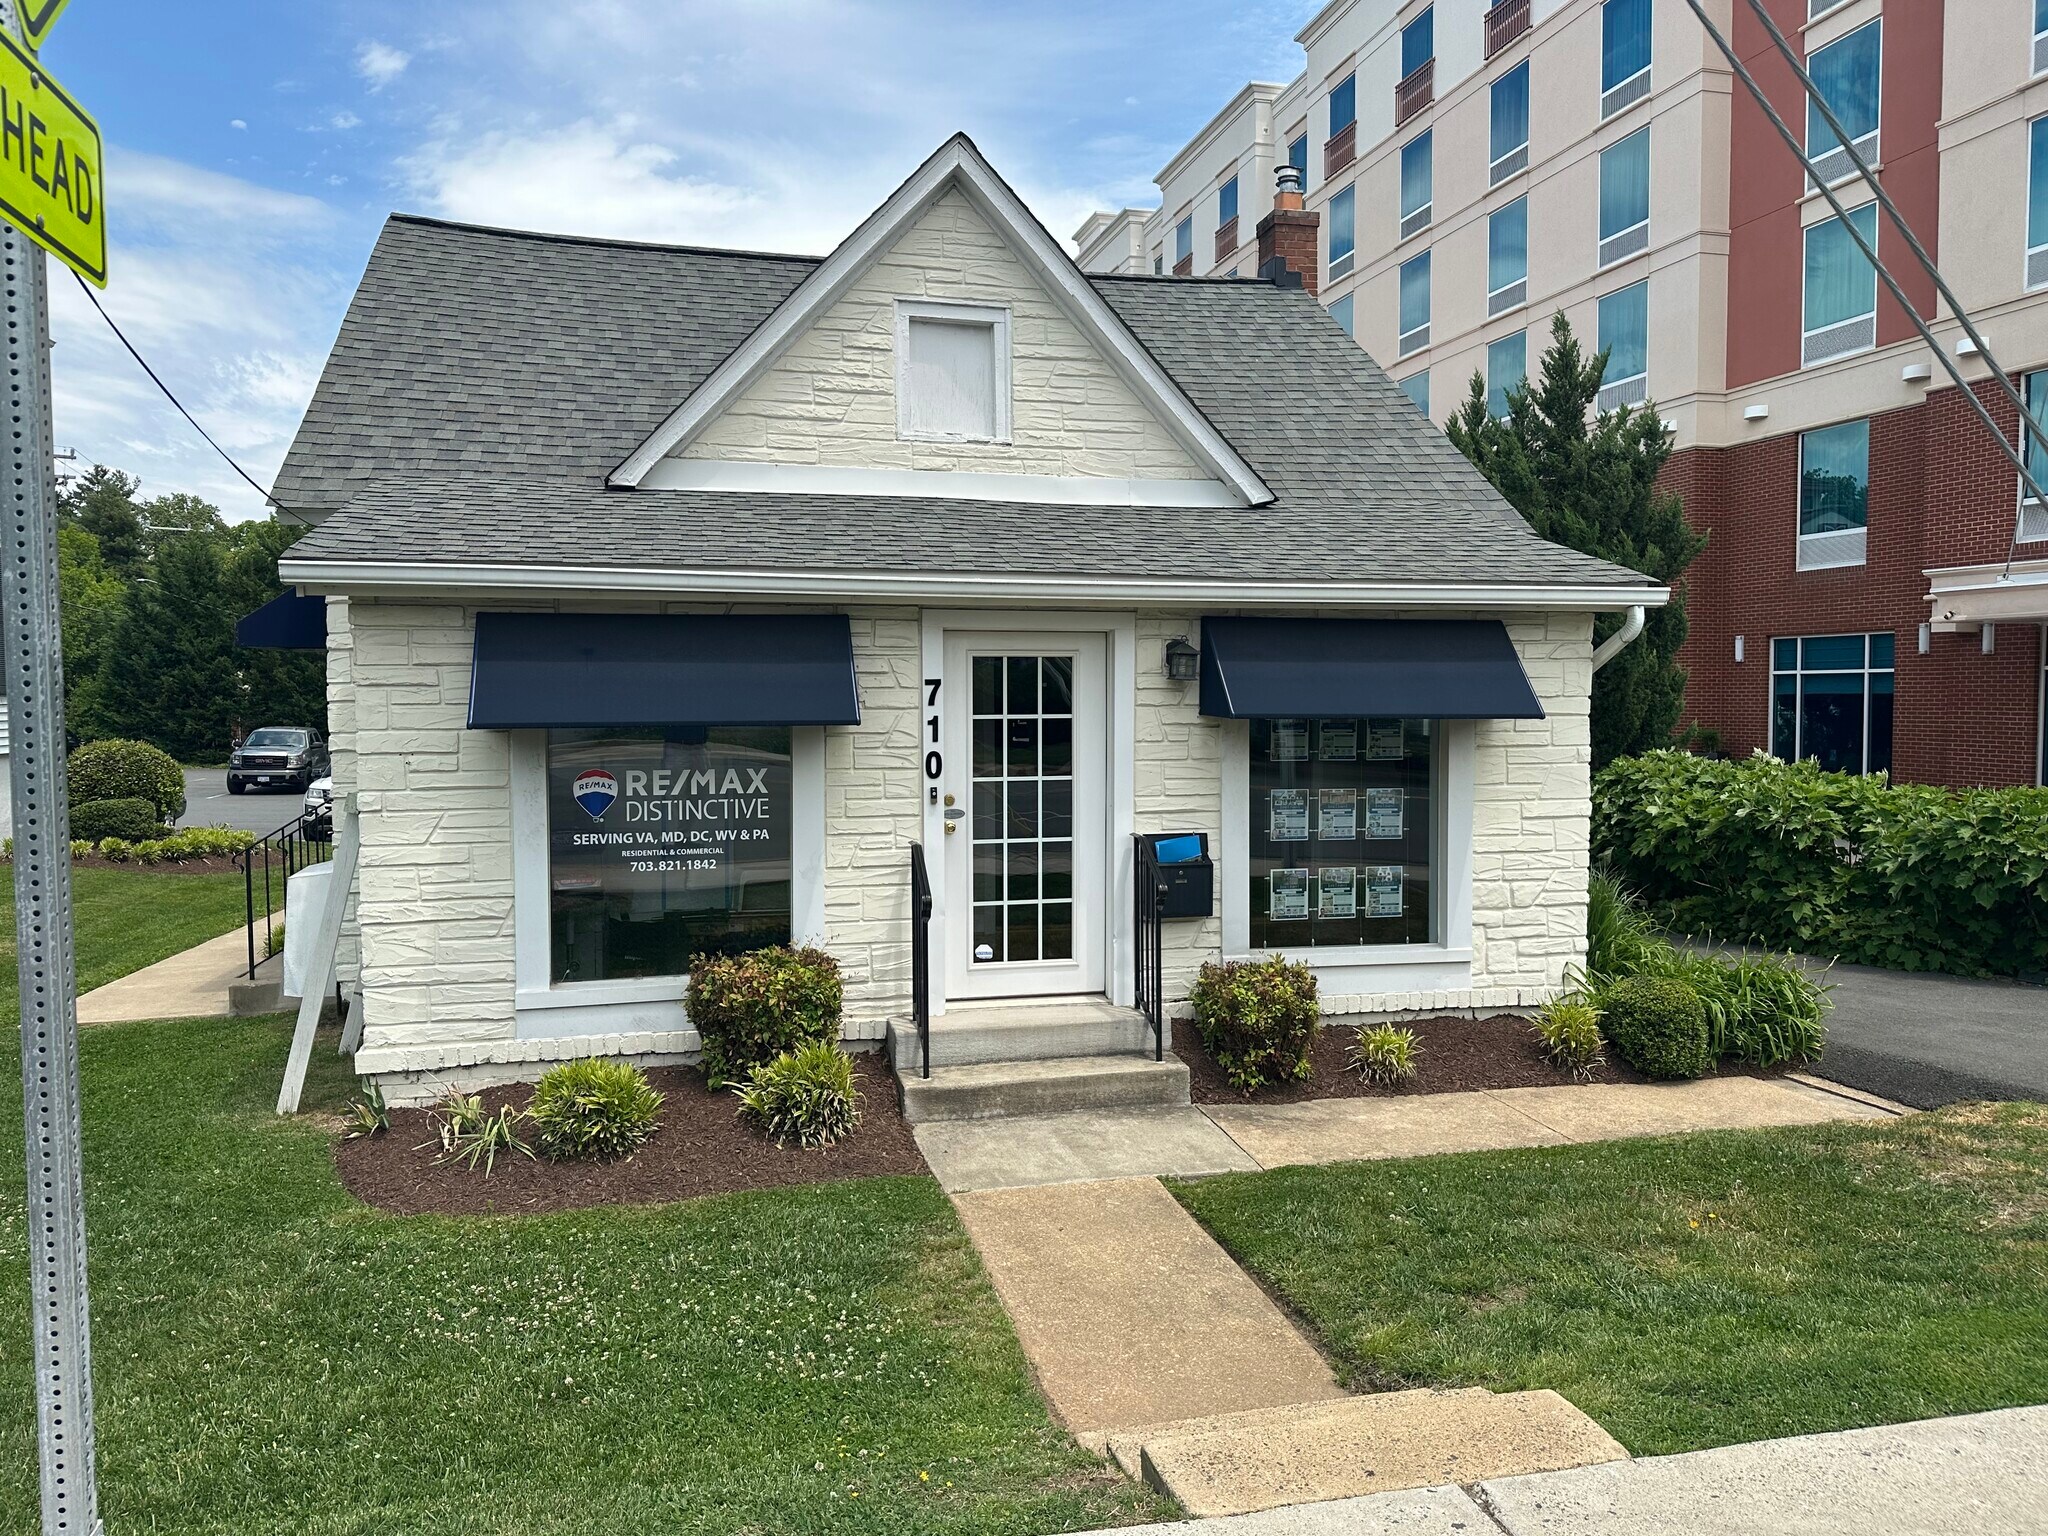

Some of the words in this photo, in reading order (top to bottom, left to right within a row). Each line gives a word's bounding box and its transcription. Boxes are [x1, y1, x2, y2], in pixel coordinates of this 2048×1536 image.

[924, 679, 943, 779] 710
[579, 781, 613, 790] RE/MAX
[625, 768, 769, 796] RE/MAX
[626, 798, 770, 822] DISTINCTIVE
[573, 833, 633, 845] SERVING
[636, 832, 658, 844] VA,
[661, 831, 687, 843] MD,
[690, 830, 712, 842] DC,
[715, 829, 737, 841] WV
[740, 829, 750, 840] &
[753, 828, 769, 840] PA
[621, 849, 668, 857] RESIDENTIAL
[676, 847, 724, 855] COMMERCIAL
[630, 859, 717, 872] 703.821.1842
